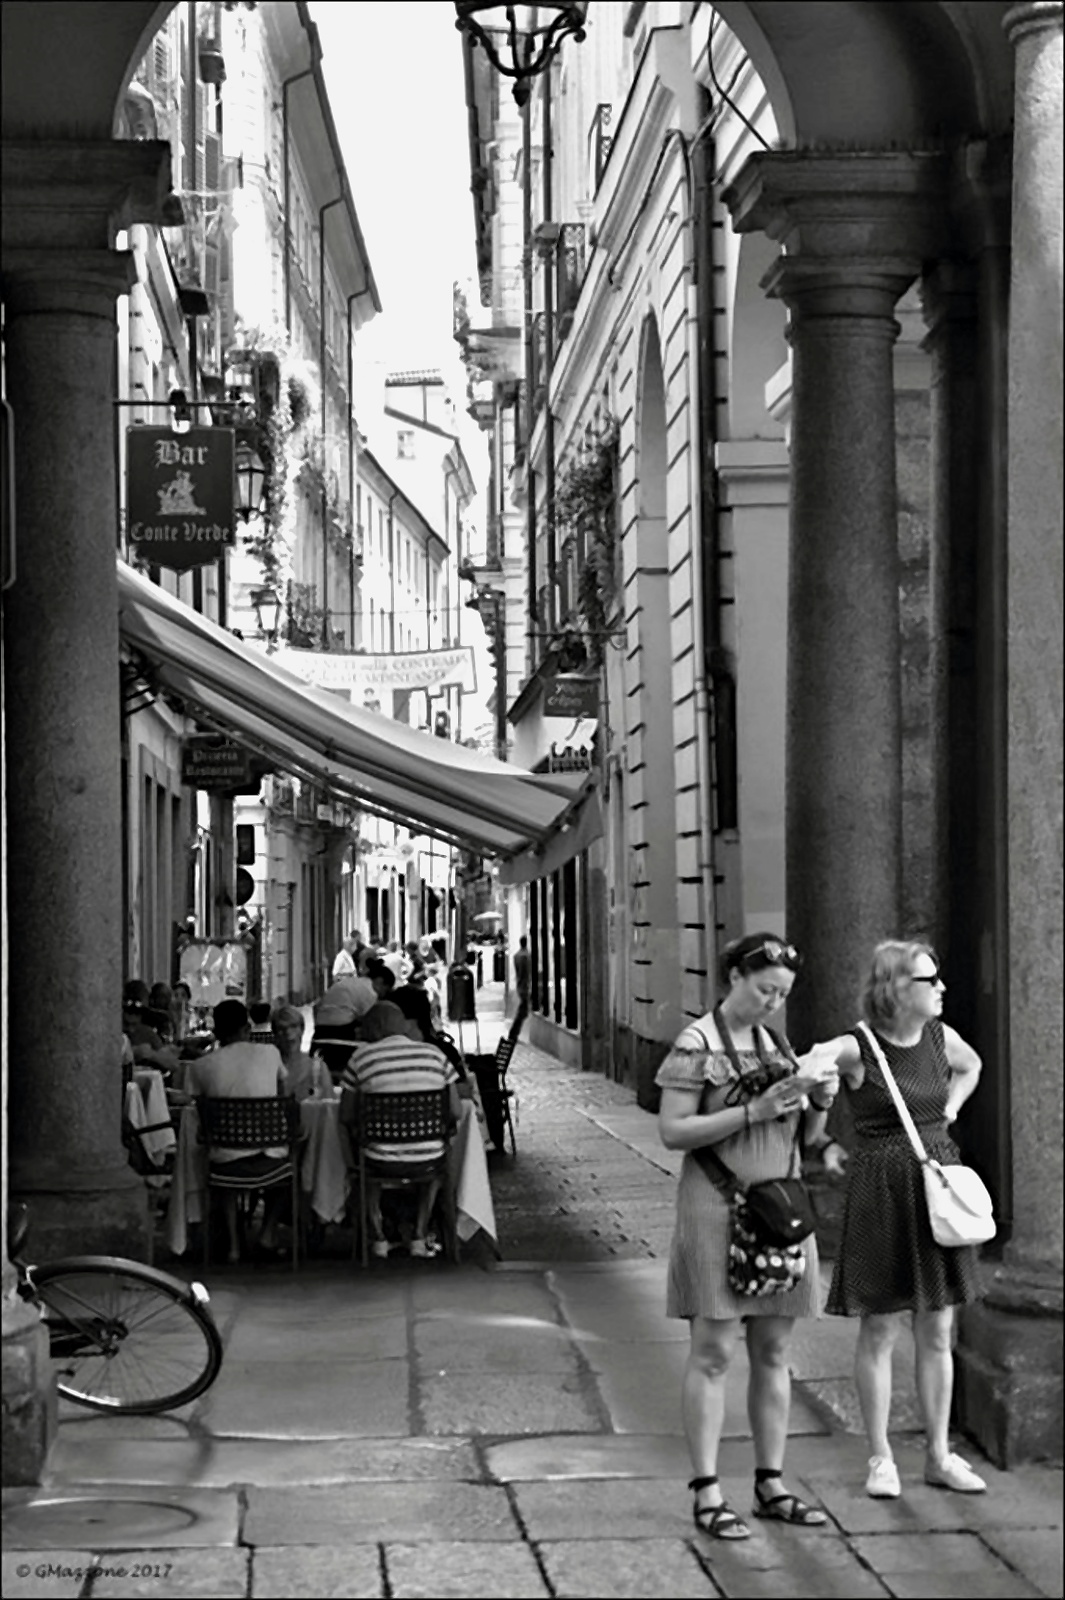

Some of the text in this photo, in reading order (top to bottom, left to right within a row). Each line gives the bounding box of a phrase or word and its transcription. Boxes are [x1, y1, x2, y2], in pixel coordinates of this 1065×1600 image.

[154, 439, 209, 469] Bar
[130, 521, 230, 542] Conte Verde
